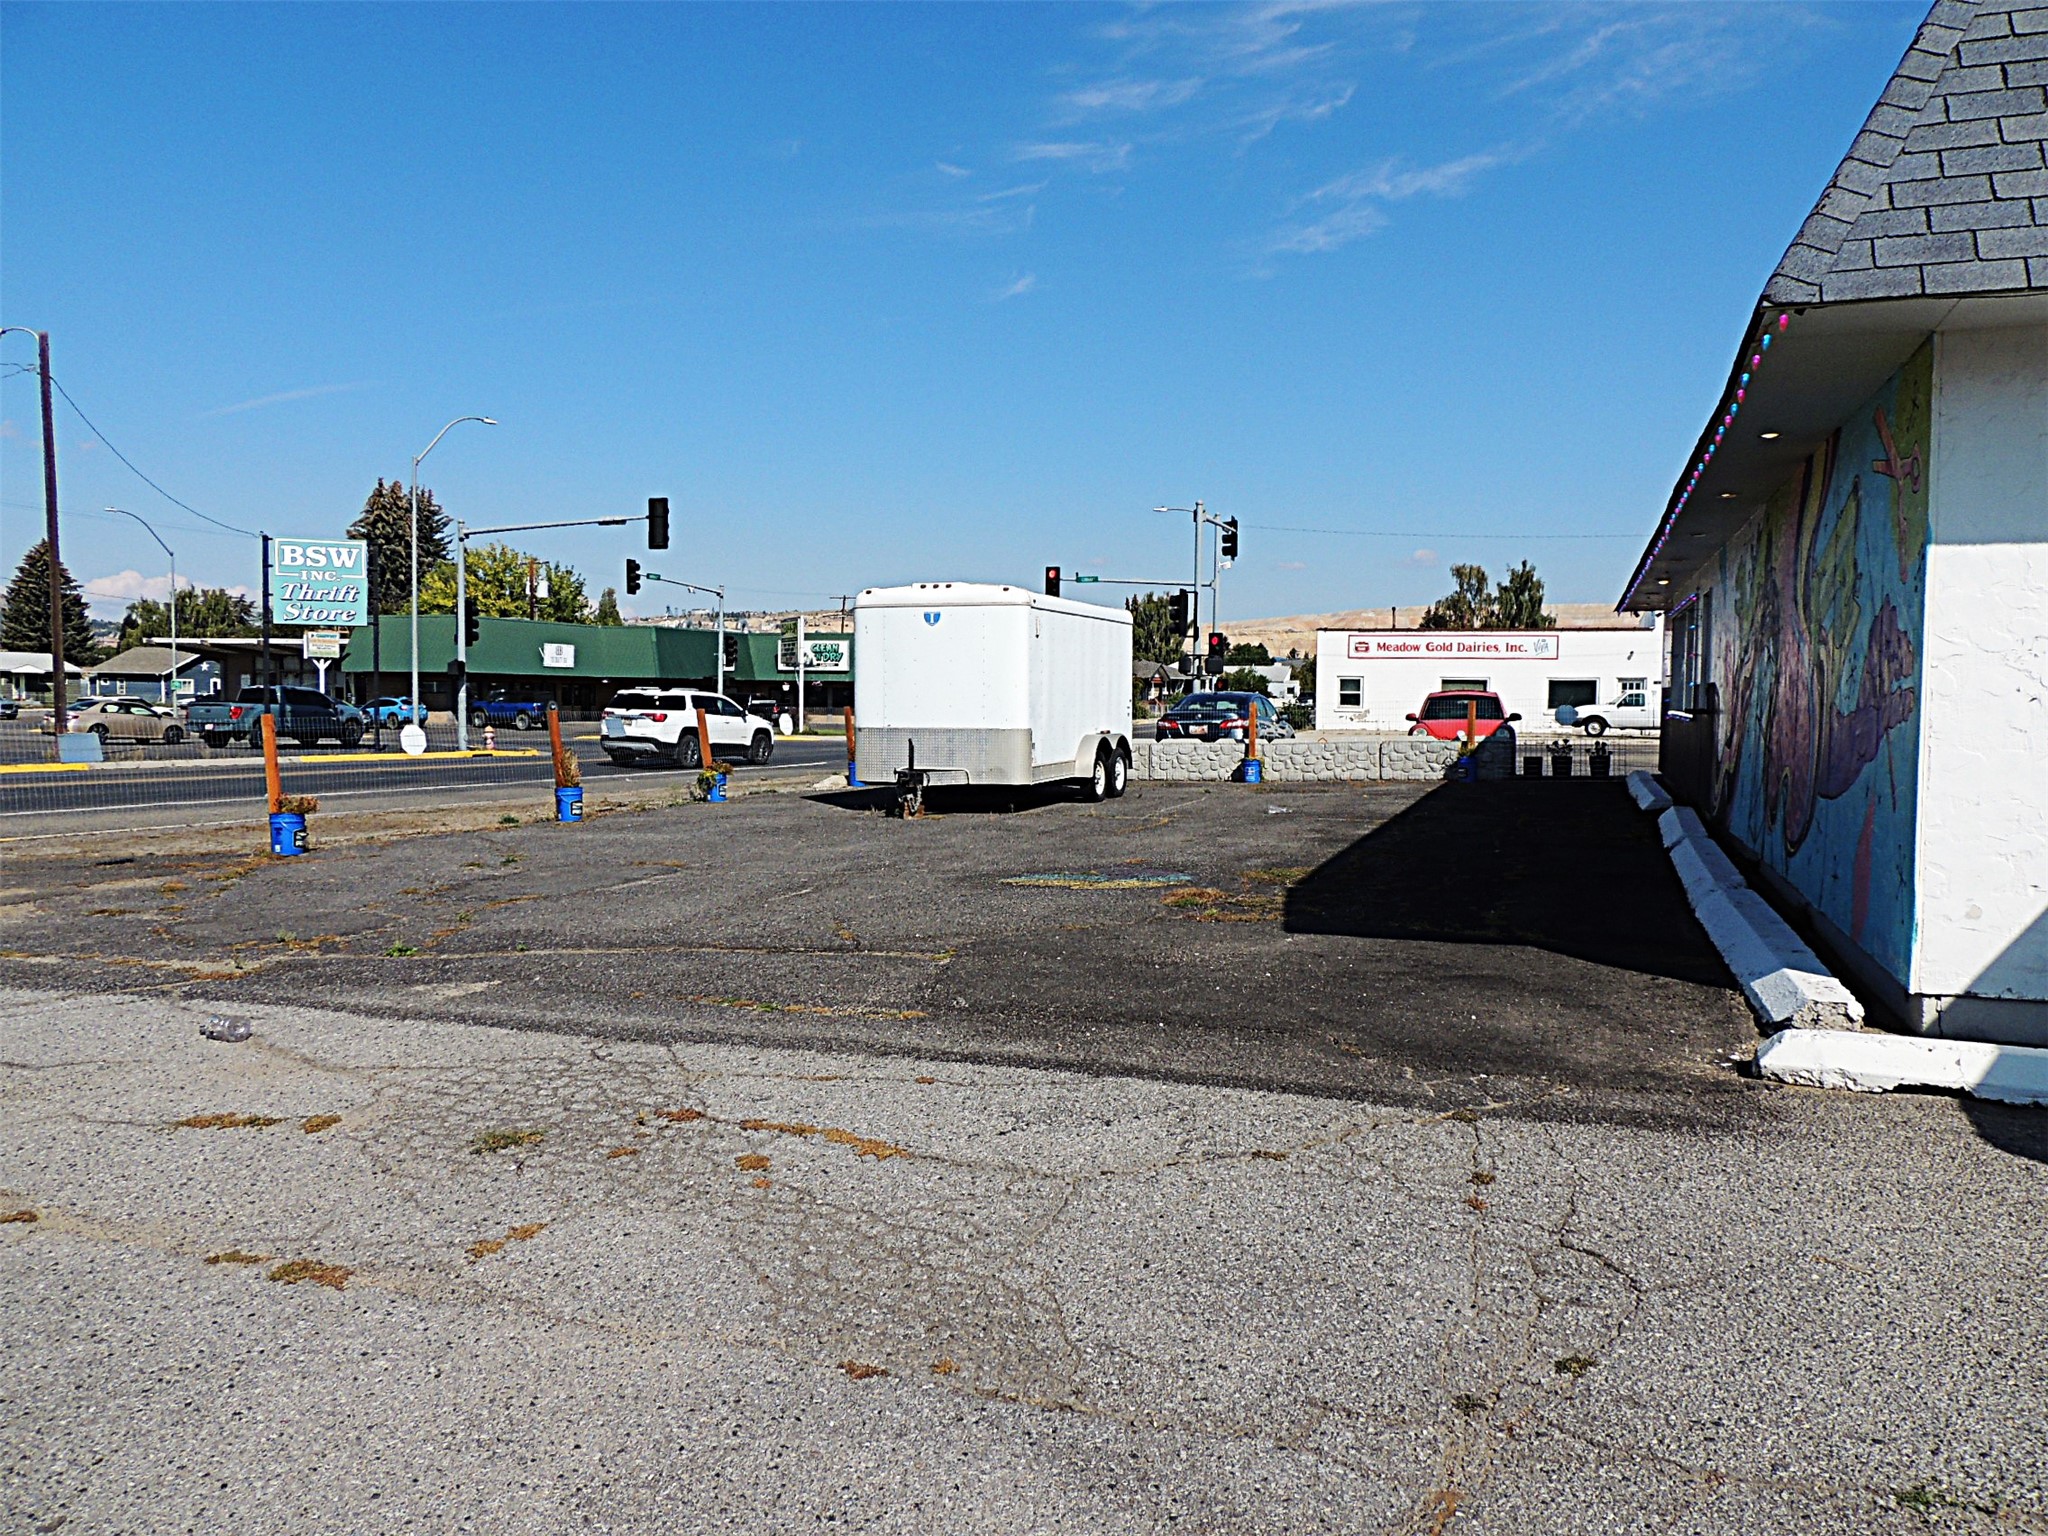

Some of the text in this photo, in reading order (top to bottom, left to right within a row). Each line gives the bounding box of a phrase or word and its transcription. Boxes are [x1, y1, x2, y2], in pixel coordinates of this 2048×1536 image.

[280, 546, 360, 568] BSW
[299, 570, 341, 581] INC.
[281, 583, 360, 603] Thrift
[283, 603, 357, 622] Store
[810, 642, 839, 653] CLEAN
[1376, 641, 1528, 654] Meadow Gold Dairies, Inc.
[822, 652, 844, 663] DRY
